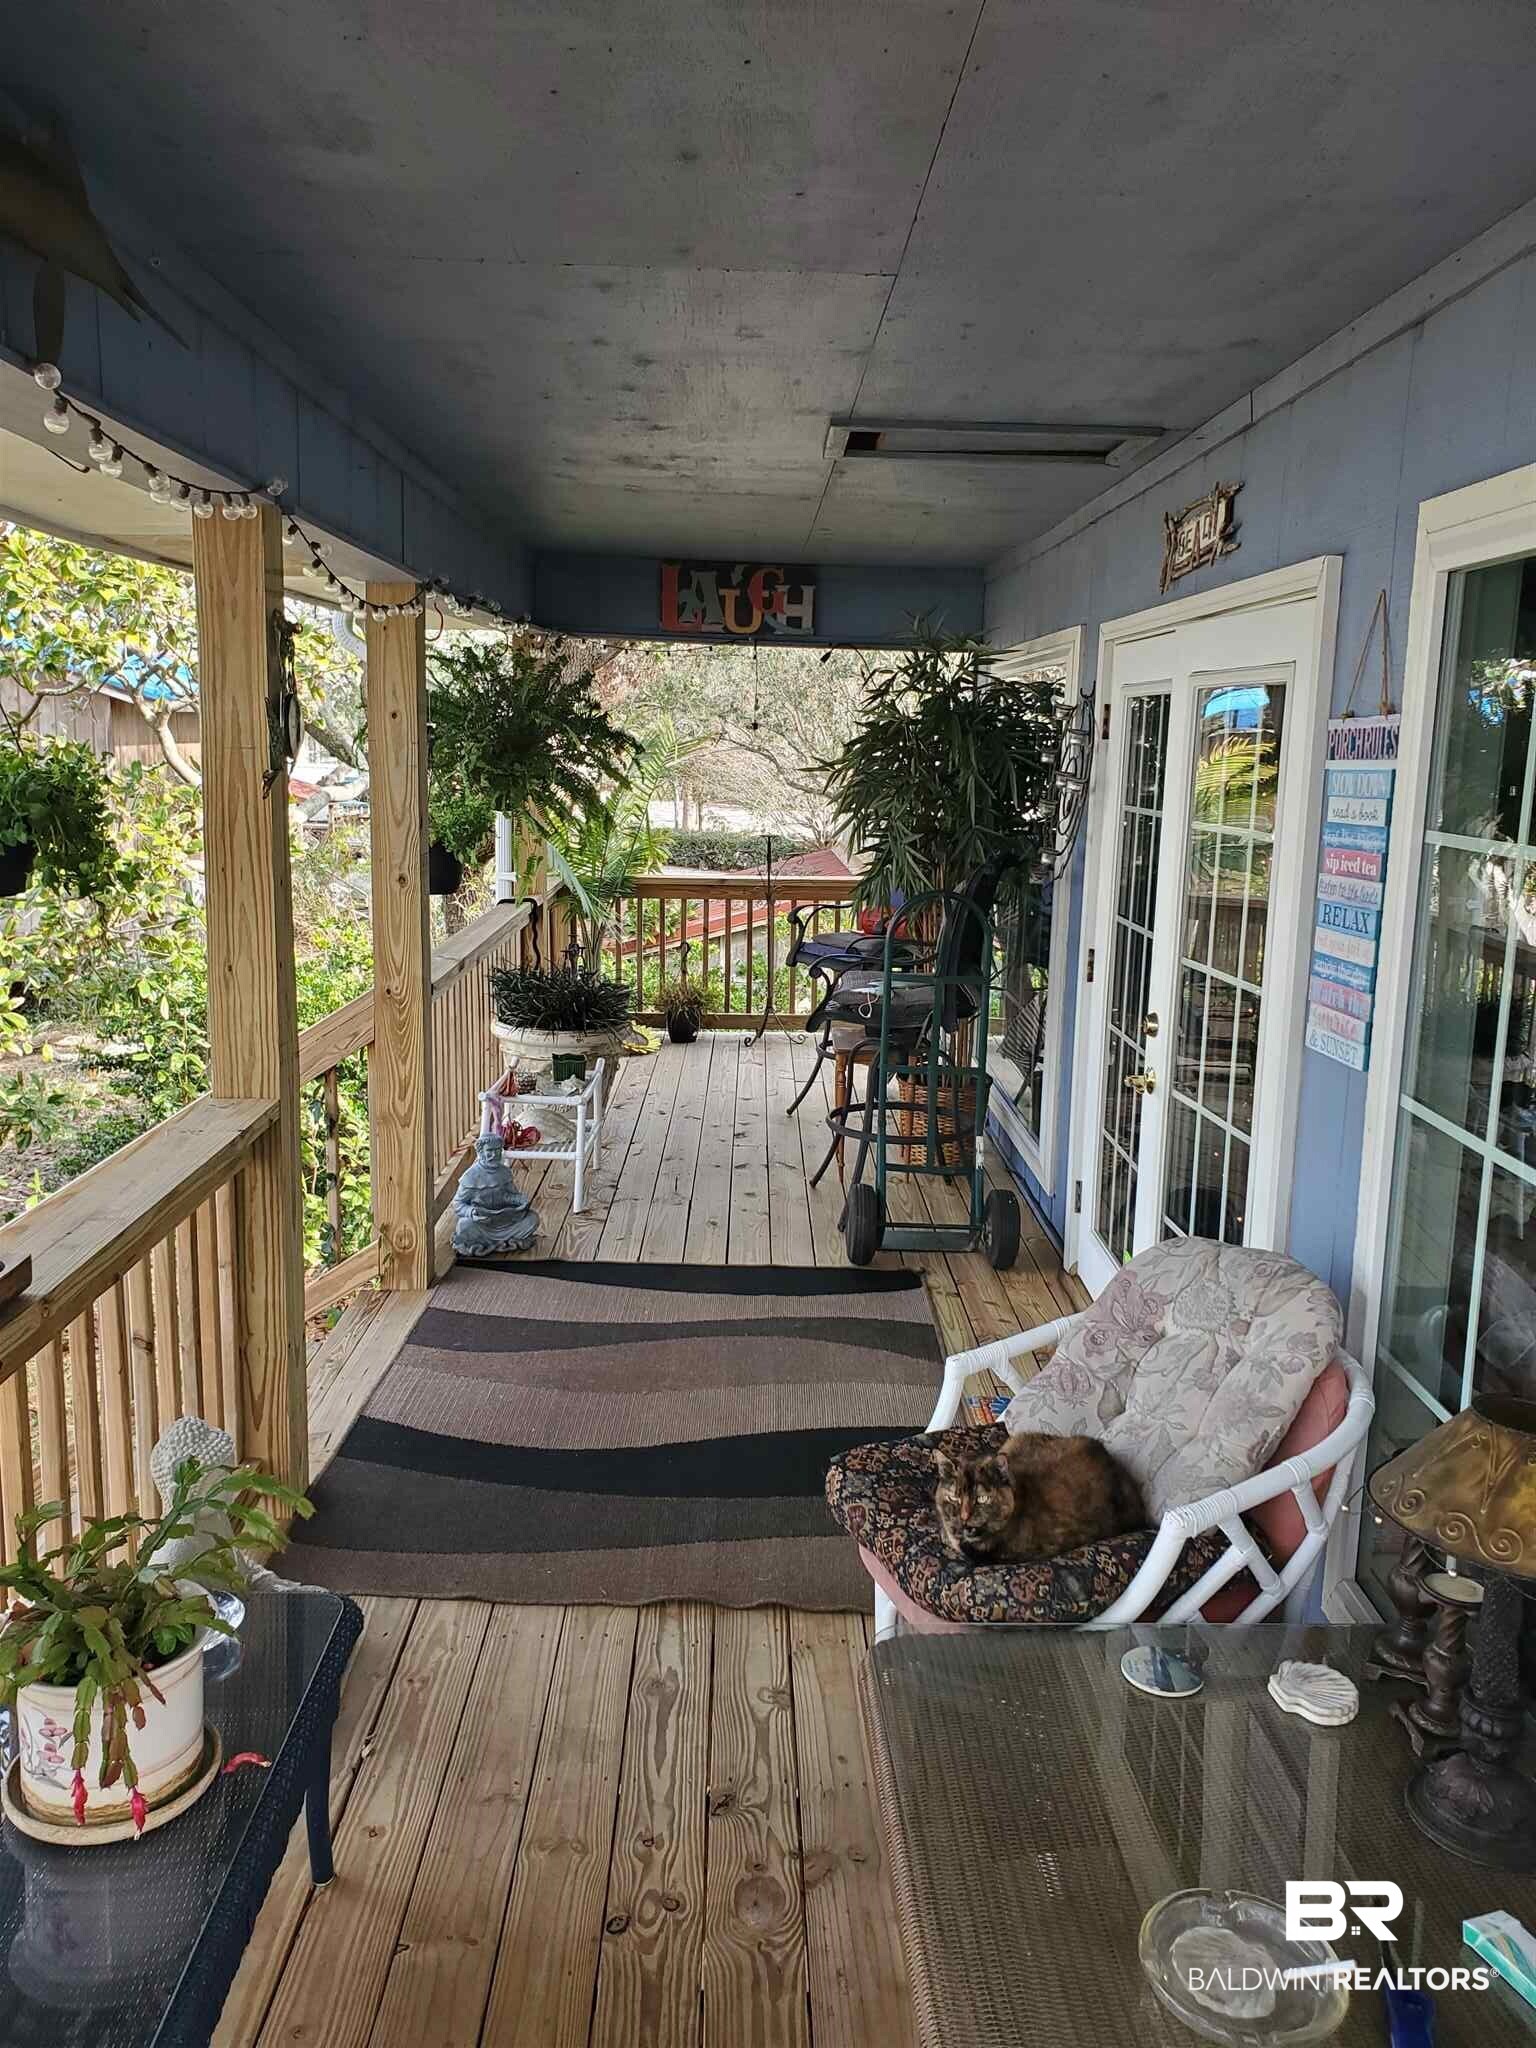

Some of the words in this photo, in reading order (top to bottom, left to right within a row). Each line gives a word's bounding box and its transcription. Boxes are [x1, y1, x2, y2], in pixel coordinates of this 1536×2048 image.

[658, 560, 816, 635] LAUGH
[1328, 728, 1362, 760] PORCH
[1363, 724, 1399, 760] RULES
[1327, 853, 1339, 874] sip
[1340, 855, 1360, 873] iced
[1361, 860, 1377, 876] tea
[1322, 903, 1370, 934] RELAX
[1319, 1034, 1358, 1065] SUNSET
